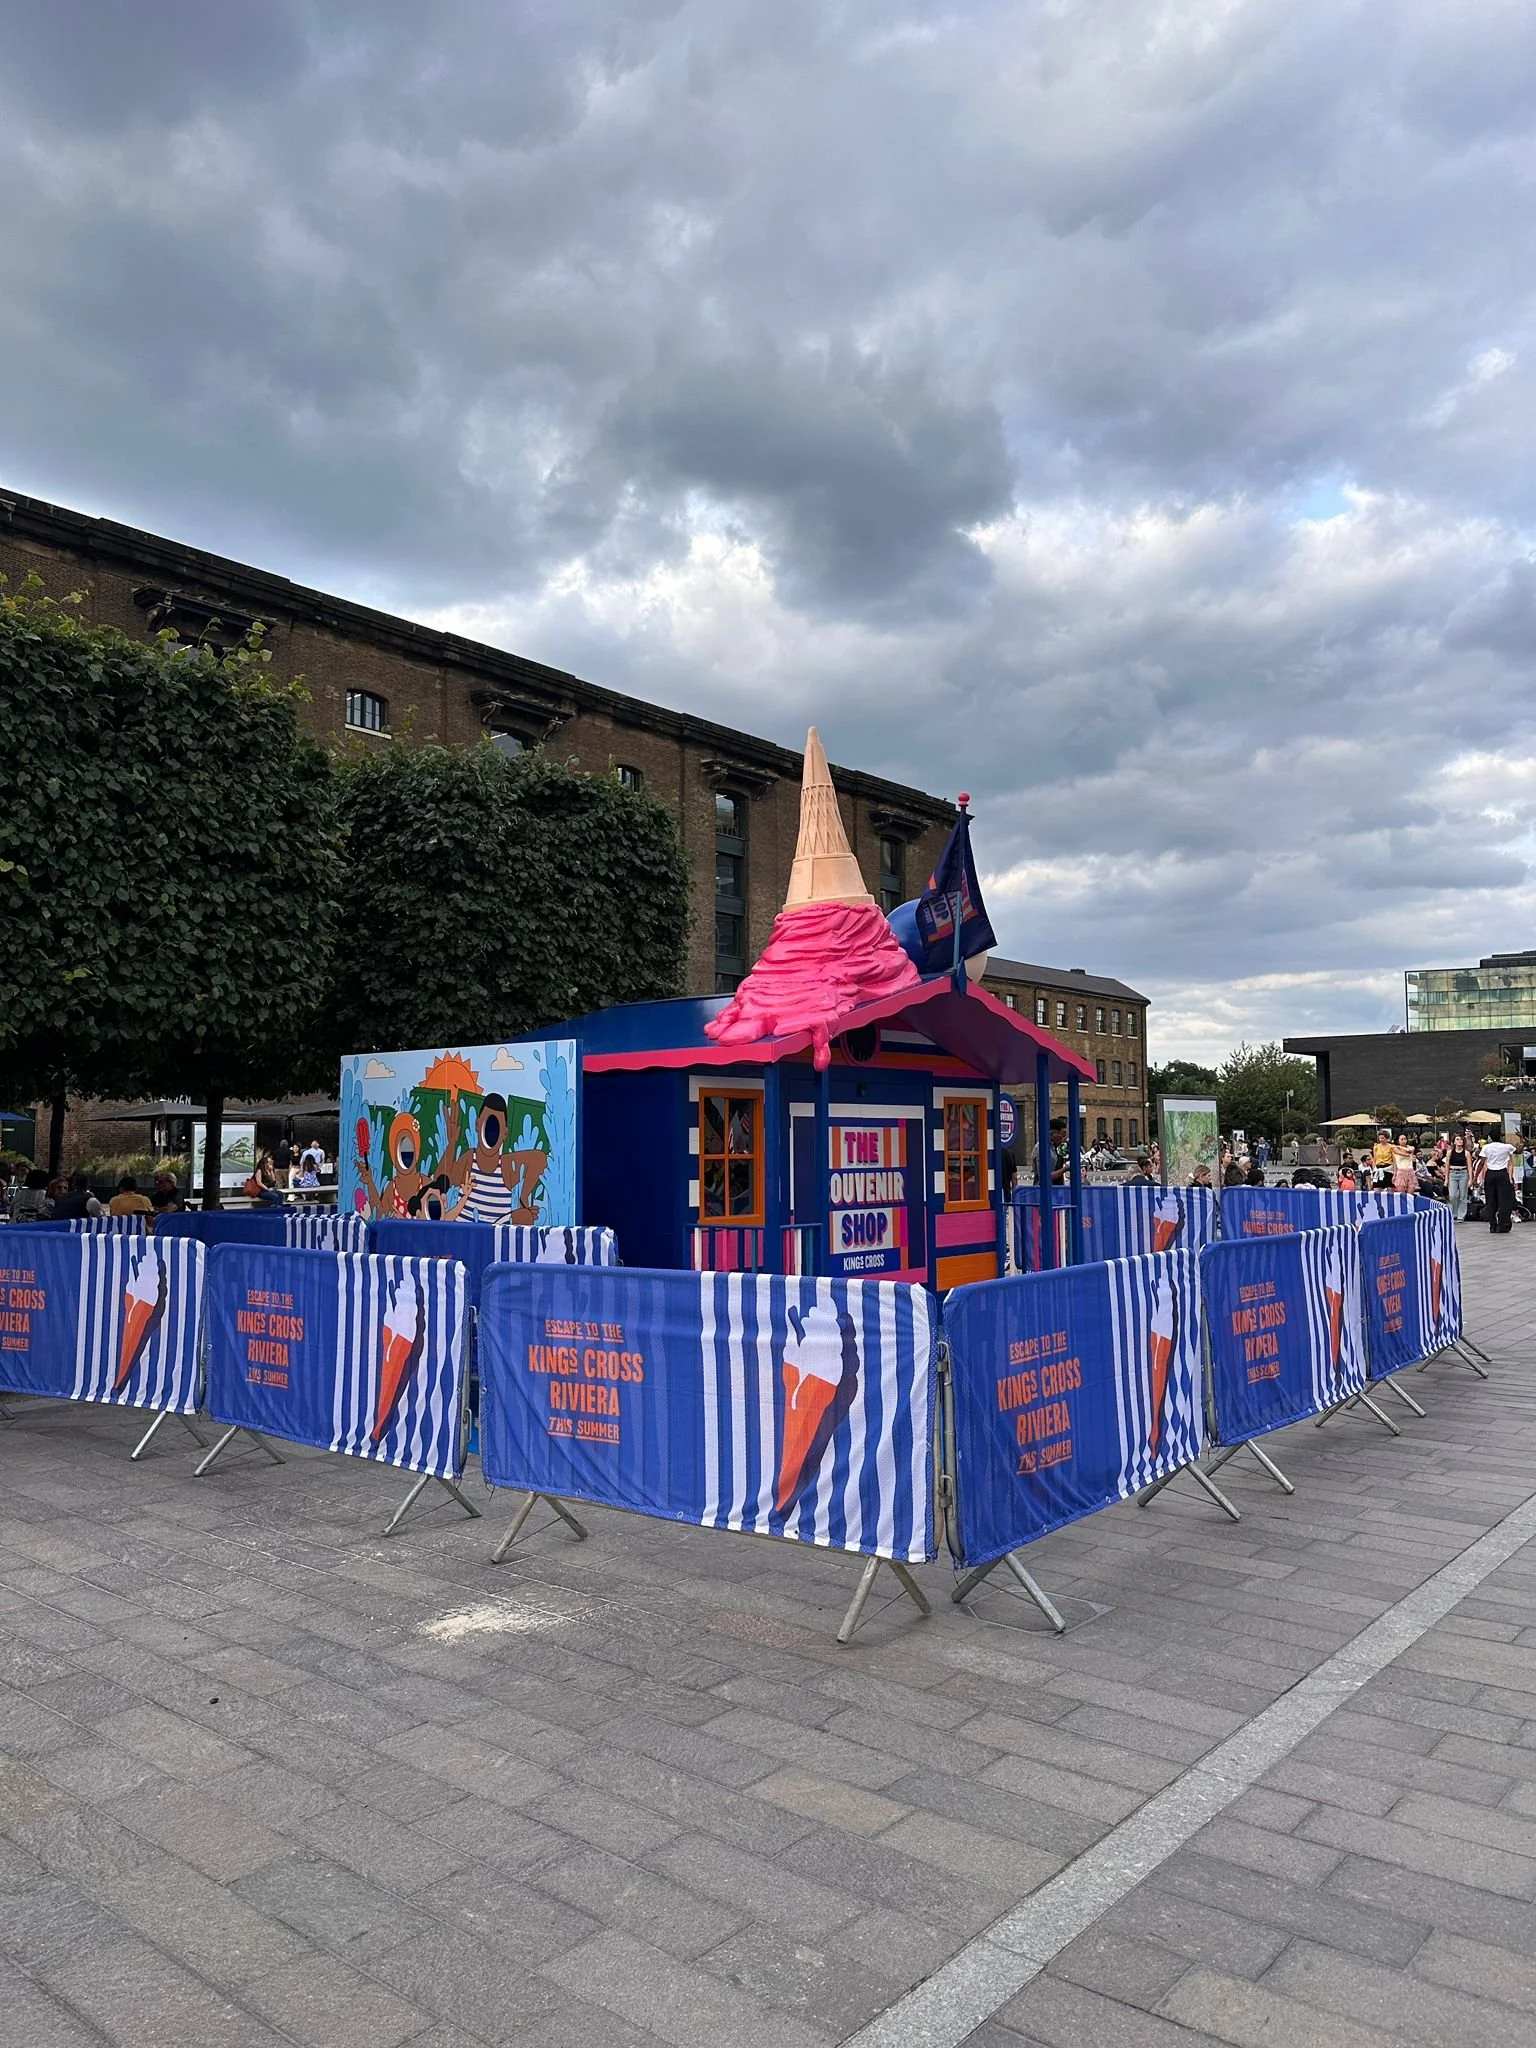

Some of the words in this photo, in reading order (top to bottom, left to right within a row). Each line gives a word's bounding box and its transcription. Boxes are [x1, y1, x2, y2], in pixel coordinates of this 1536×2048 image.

[844, 1131, 879, 1164] THE
[831, 1171, 904, 1205] OUVENIR
[841, 1212, 888, 1247] SHOP
[864, 1253, 885, 1268] CROSS
[12, 1269, 20, 1281] TO
[22, 1270, 35, 1282] THE
[9, 1287, 46, 1310] CROSS
[248, 1289, 270, 1303] ESCAPE
[271, 1291, 280, 1304] TO
[281, 1293, 293, 1306] THE
[237, 1309, 266, 1334] KINGS
[269, 1313, 304, 1341] CROSS
[545, 1319, 583, 1336] ESCAPE
[584, 1321, 599, 1337] TO
[601, 1323, 623, 1339] THE
[1259, 1301, 1286, 1330] CROSS
[2, 1335, 29, 1348] SUMMER
[247, 1338, 289, 1367] RIVIERA
[1009, 1338, 1039, 1361] ESCAPE
[1040, 1335, 1051, 1352] TO
[1052, 1331, 1067, 1349] THE
[263, 1369, 289, 1386] SUMMER
[528, 1344, 578, 1375] KINGS
[584, 1348, 644, 1383] CROSS
[550, 1380, 620, 1417] RIVIERA
[997, 1369, 1039, 1412] KINGS
[1041, 1356, 1082, 1398] CROSS
[547, 1416, 574, 1433] THIS
[577, 1419, 620, 1440] SUMMER
[1016, 1400, 1071, 1446] RIVIERA
[1039, 1439, 1073, 1465] SUMMER
